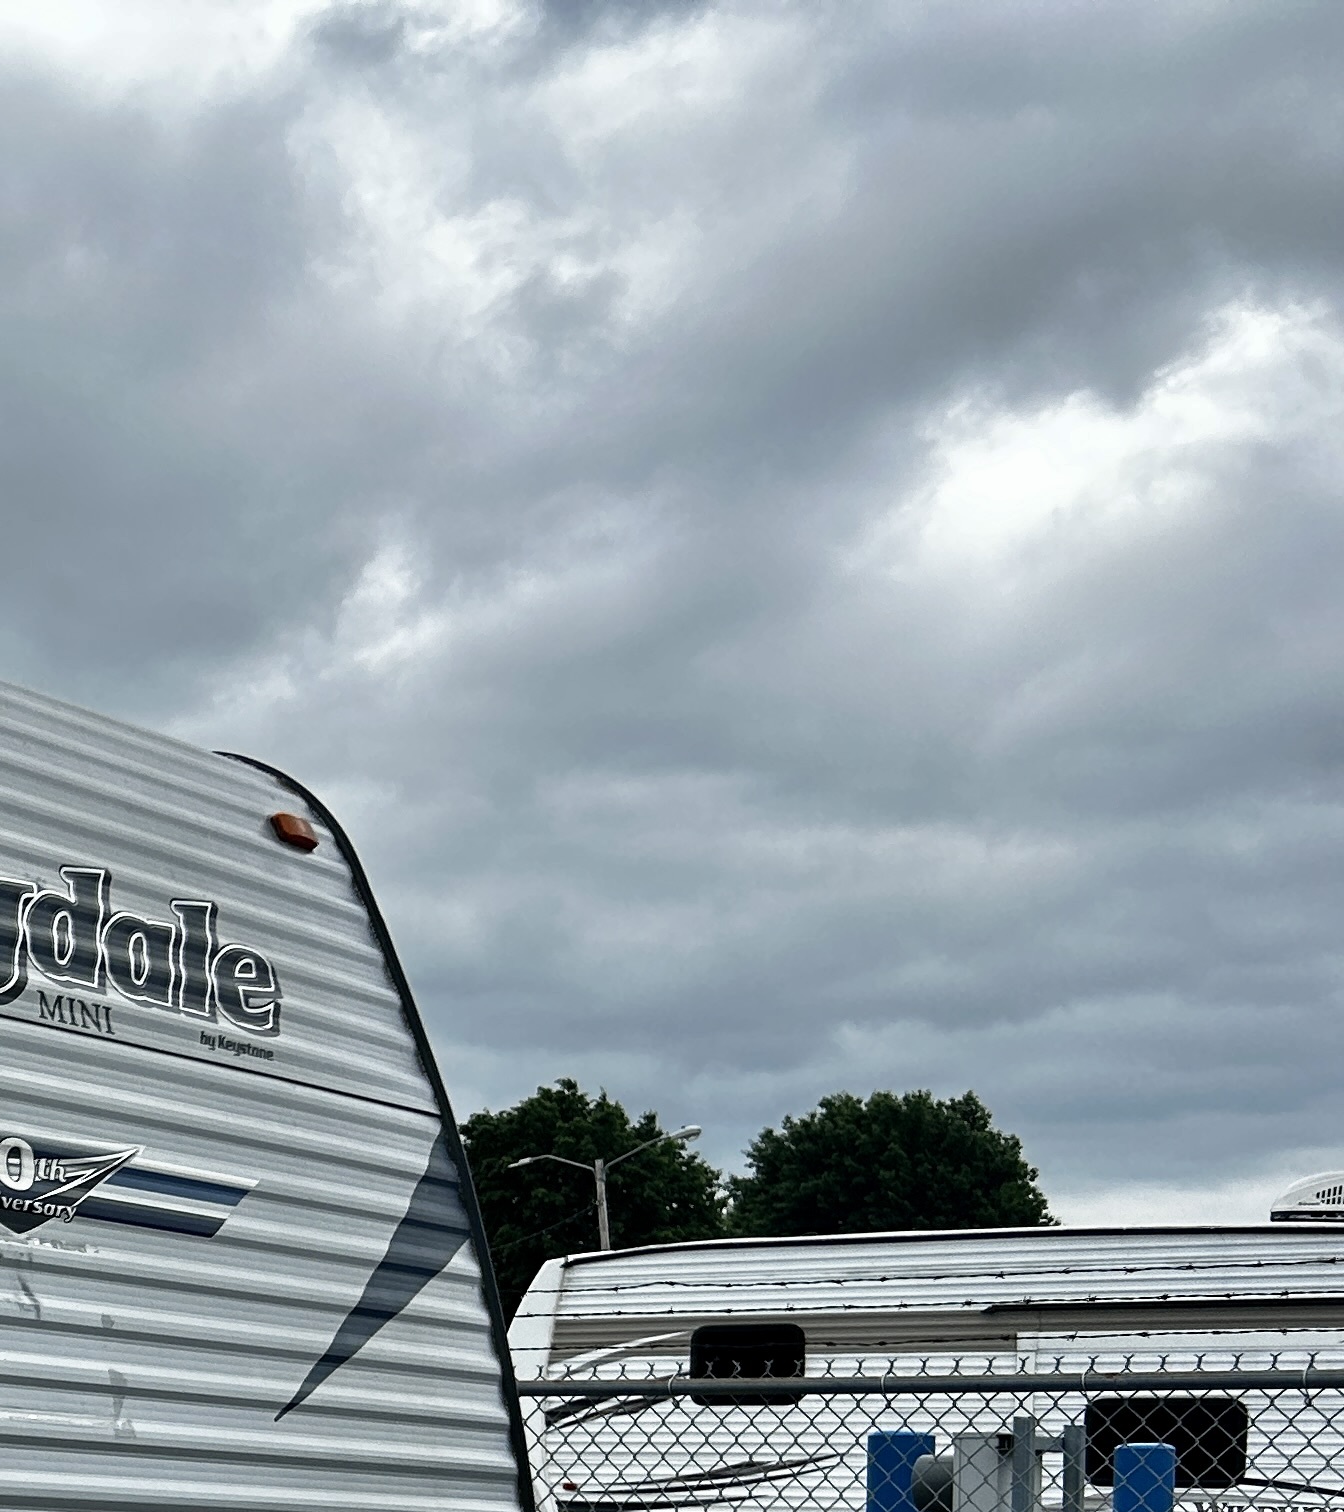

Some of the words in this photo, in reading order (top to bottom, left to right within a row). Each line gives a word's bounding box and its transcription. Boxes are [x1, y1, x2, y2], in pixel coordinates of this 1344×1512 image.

[36, 990, 116, 1036] MINI
[199, 1030, 216, 1051] by
[216, 1034, 275, 1062] Keystone
